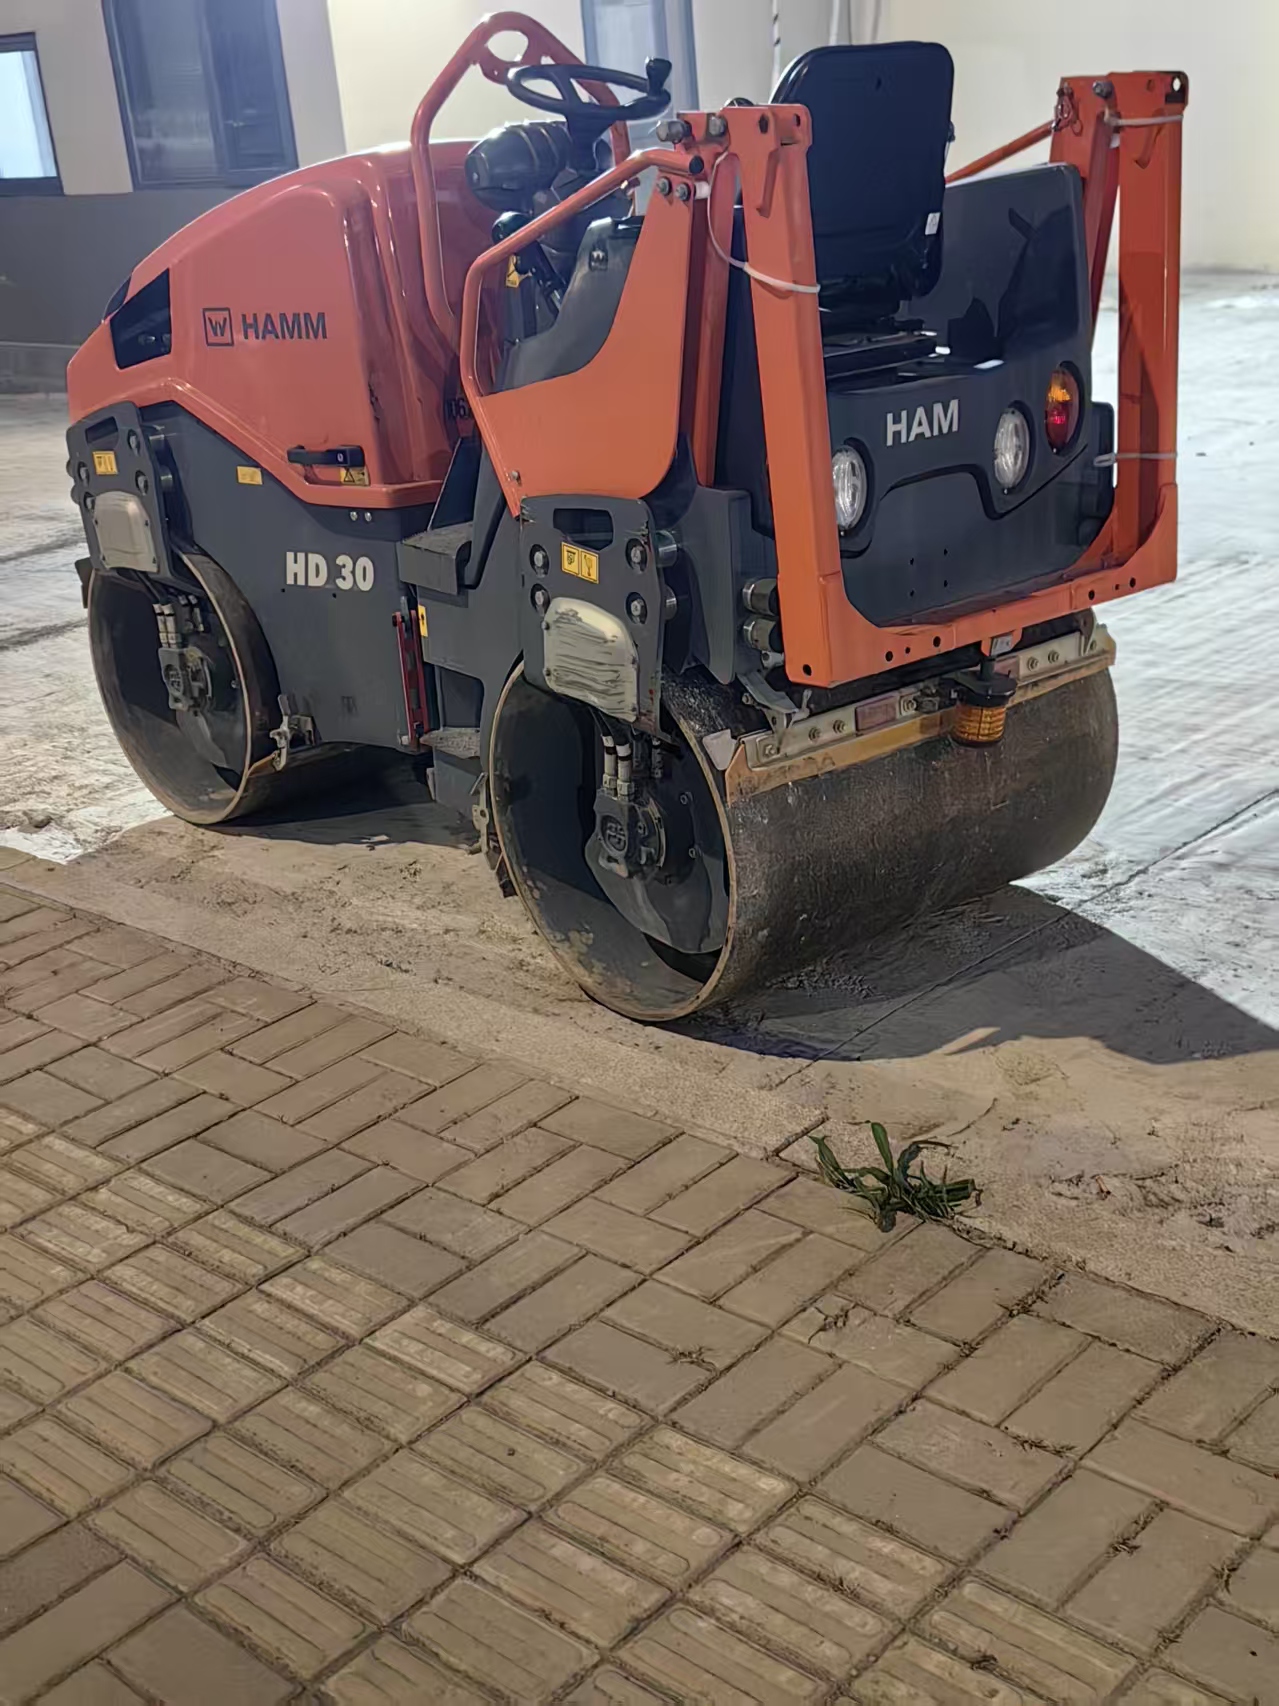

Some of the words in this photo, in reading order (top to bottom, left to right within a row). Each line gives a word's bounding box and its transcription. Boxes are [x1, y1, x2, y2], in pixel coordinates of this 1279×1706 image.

[241, 312, 328, 340] HAMM
[886, 398, 960, 447] HAM
[286, 551, 328, 587] HD
[335, 554, 375, 592] 30
